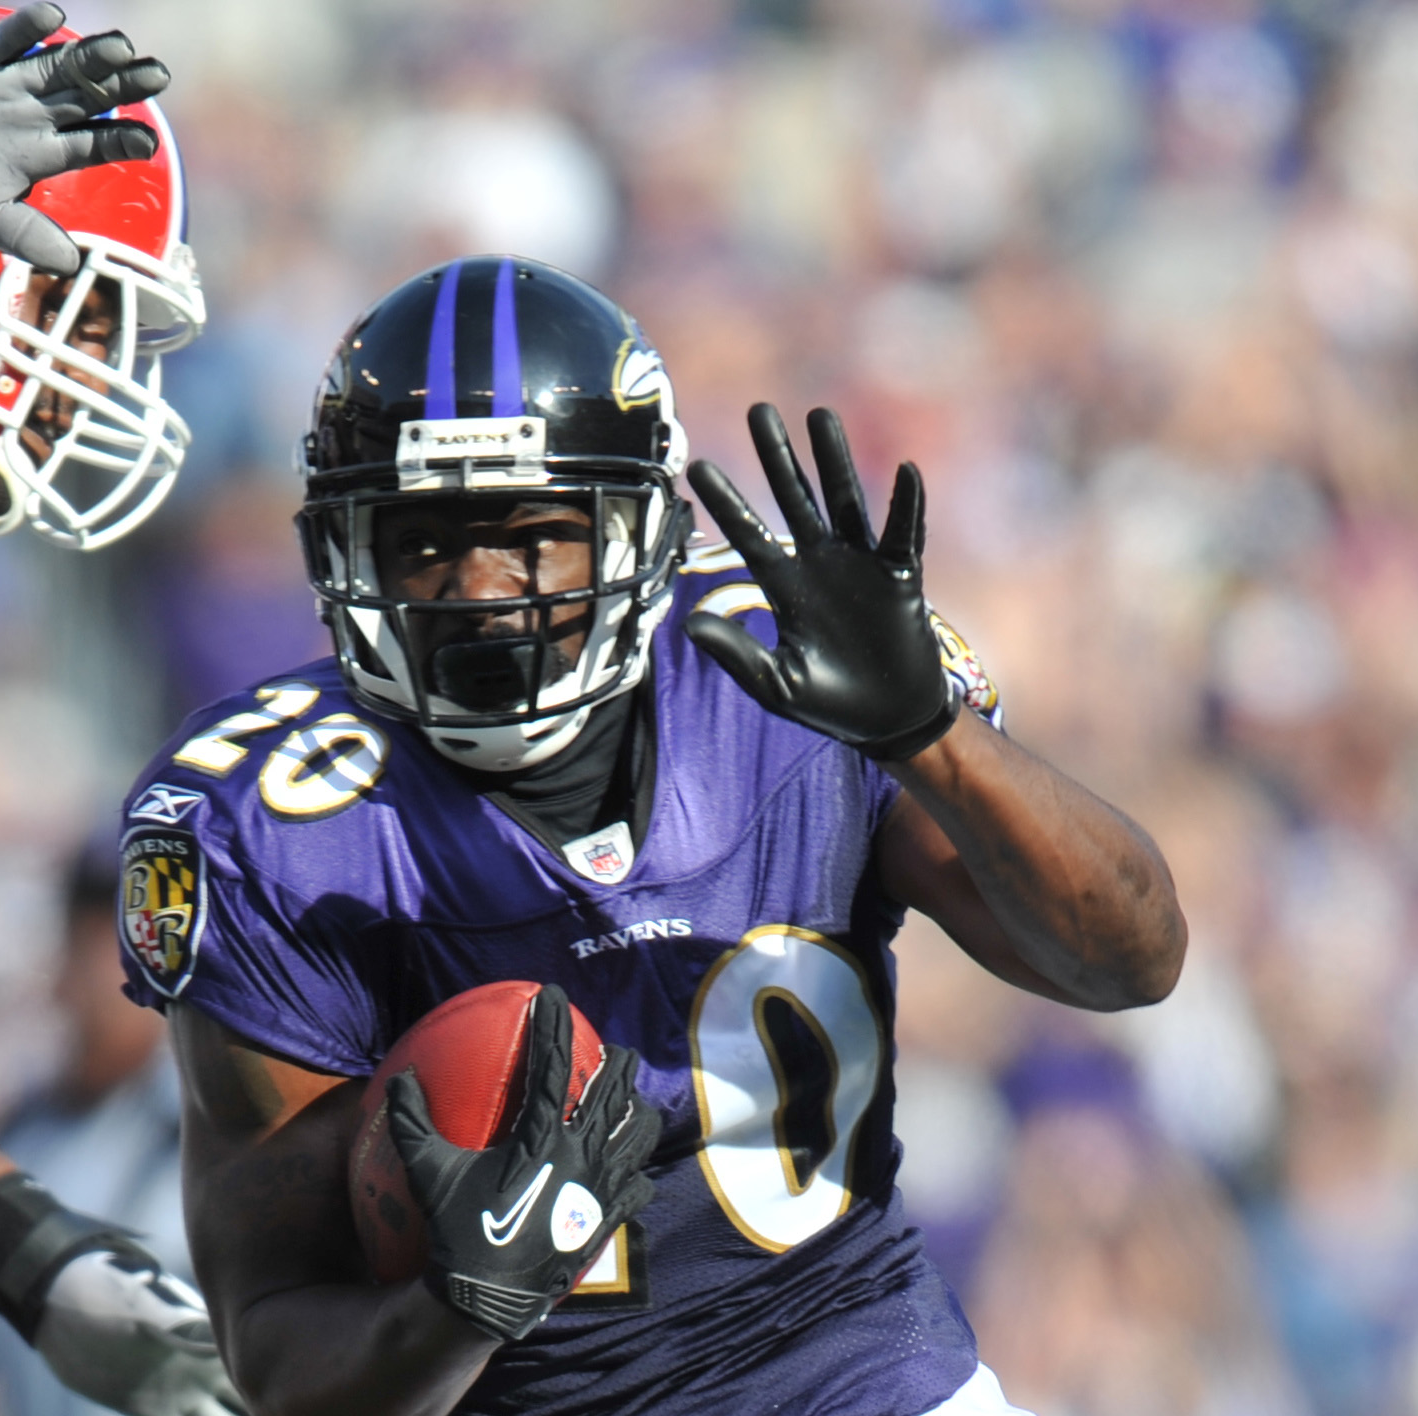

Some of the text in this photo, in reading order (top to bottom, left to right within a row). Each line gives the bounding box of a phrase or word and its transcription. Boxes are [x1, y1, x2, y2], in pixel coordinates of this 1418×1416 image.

[434, 433, 510, 446] RAVENS
[172, 680, 391, 823] 20
[569, 918, 692, 959] RAVENS
